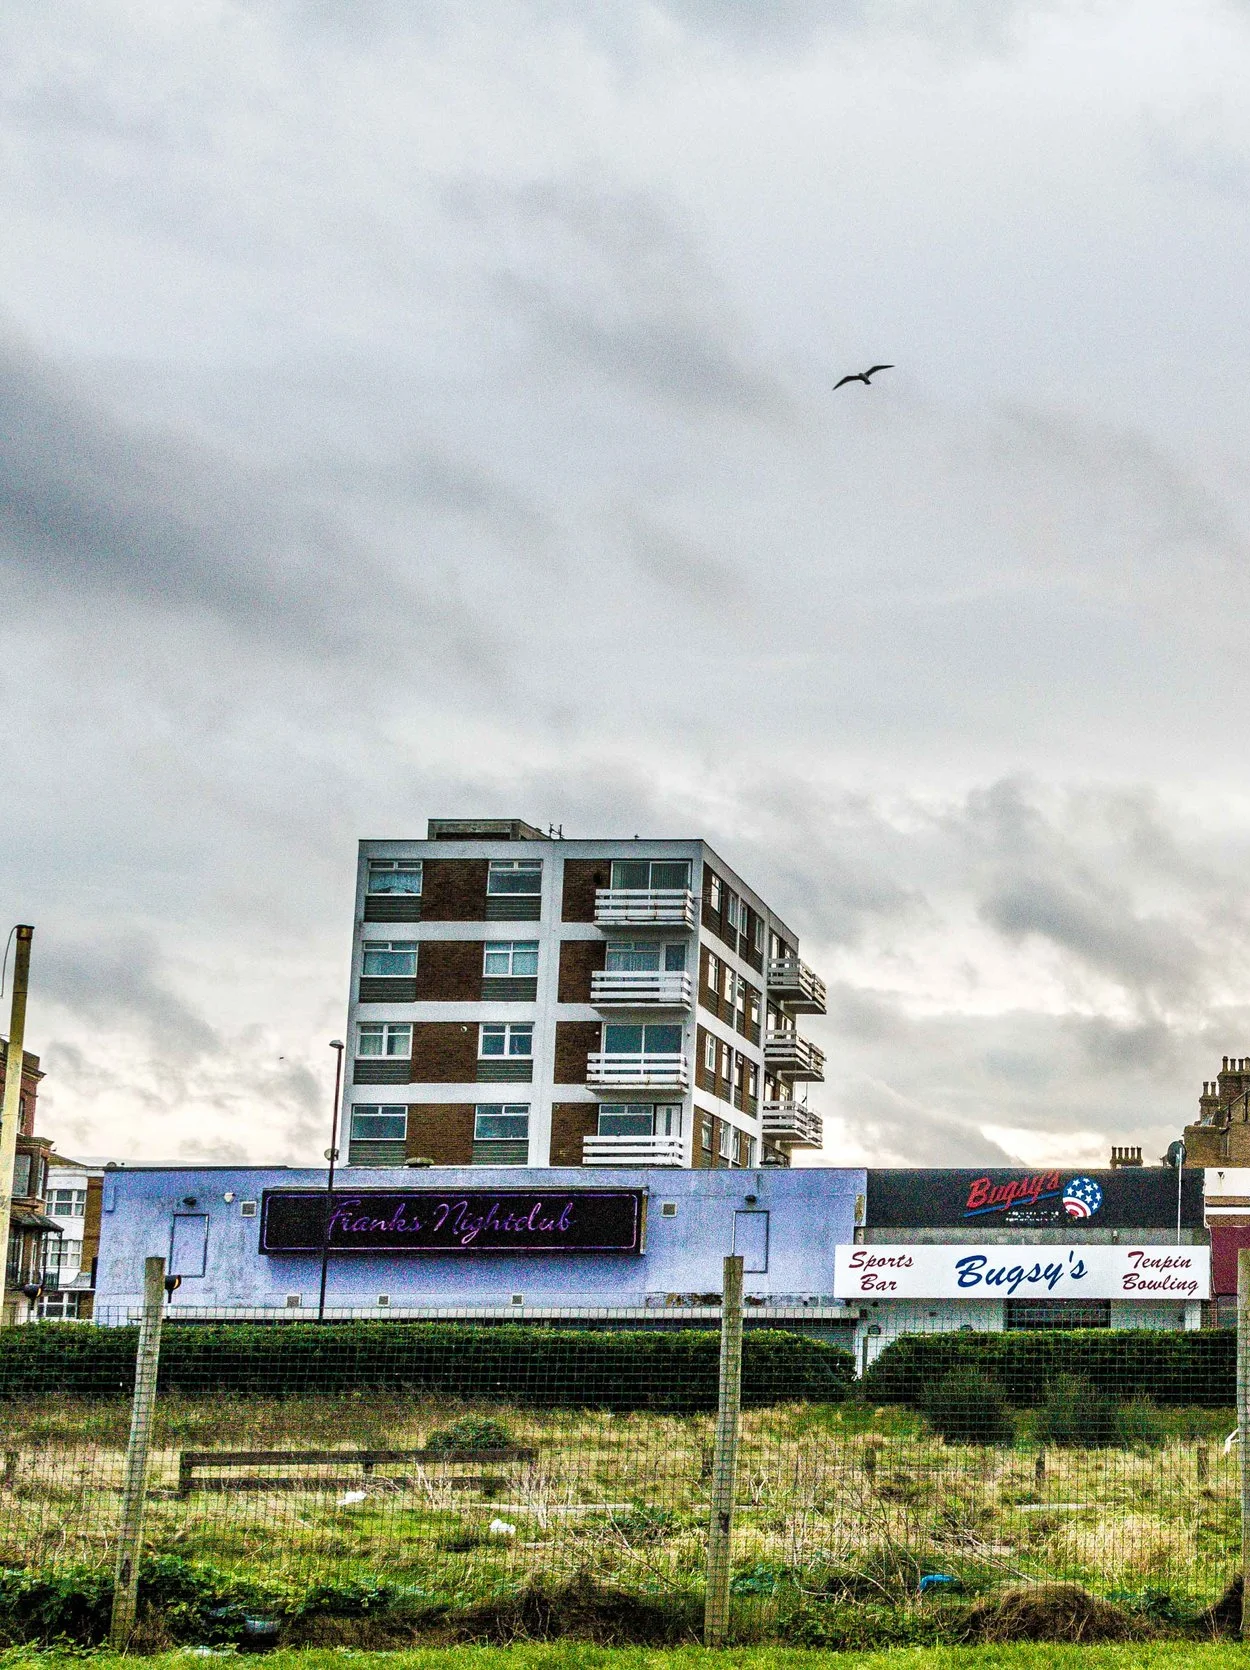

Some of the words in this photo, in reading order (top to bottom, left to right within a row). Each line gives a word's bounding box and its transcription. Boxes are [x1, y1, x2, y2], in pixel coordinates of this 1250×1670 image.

[966, 1170, 1061, 1212] Bugsy's
[328, 1199, 424, 1240] Franks
[432, 1200, 578, 1244] Nightclub
[848, 1251, 914, 1271] Sports
[955, 1250, 1088, 1295] Bugsy's
[1127, 1250, 1192, 1273] Tenpin
[860, 1273, 897, 1291] Bar
[1122, 1272, 1199, 1296] Bowling
